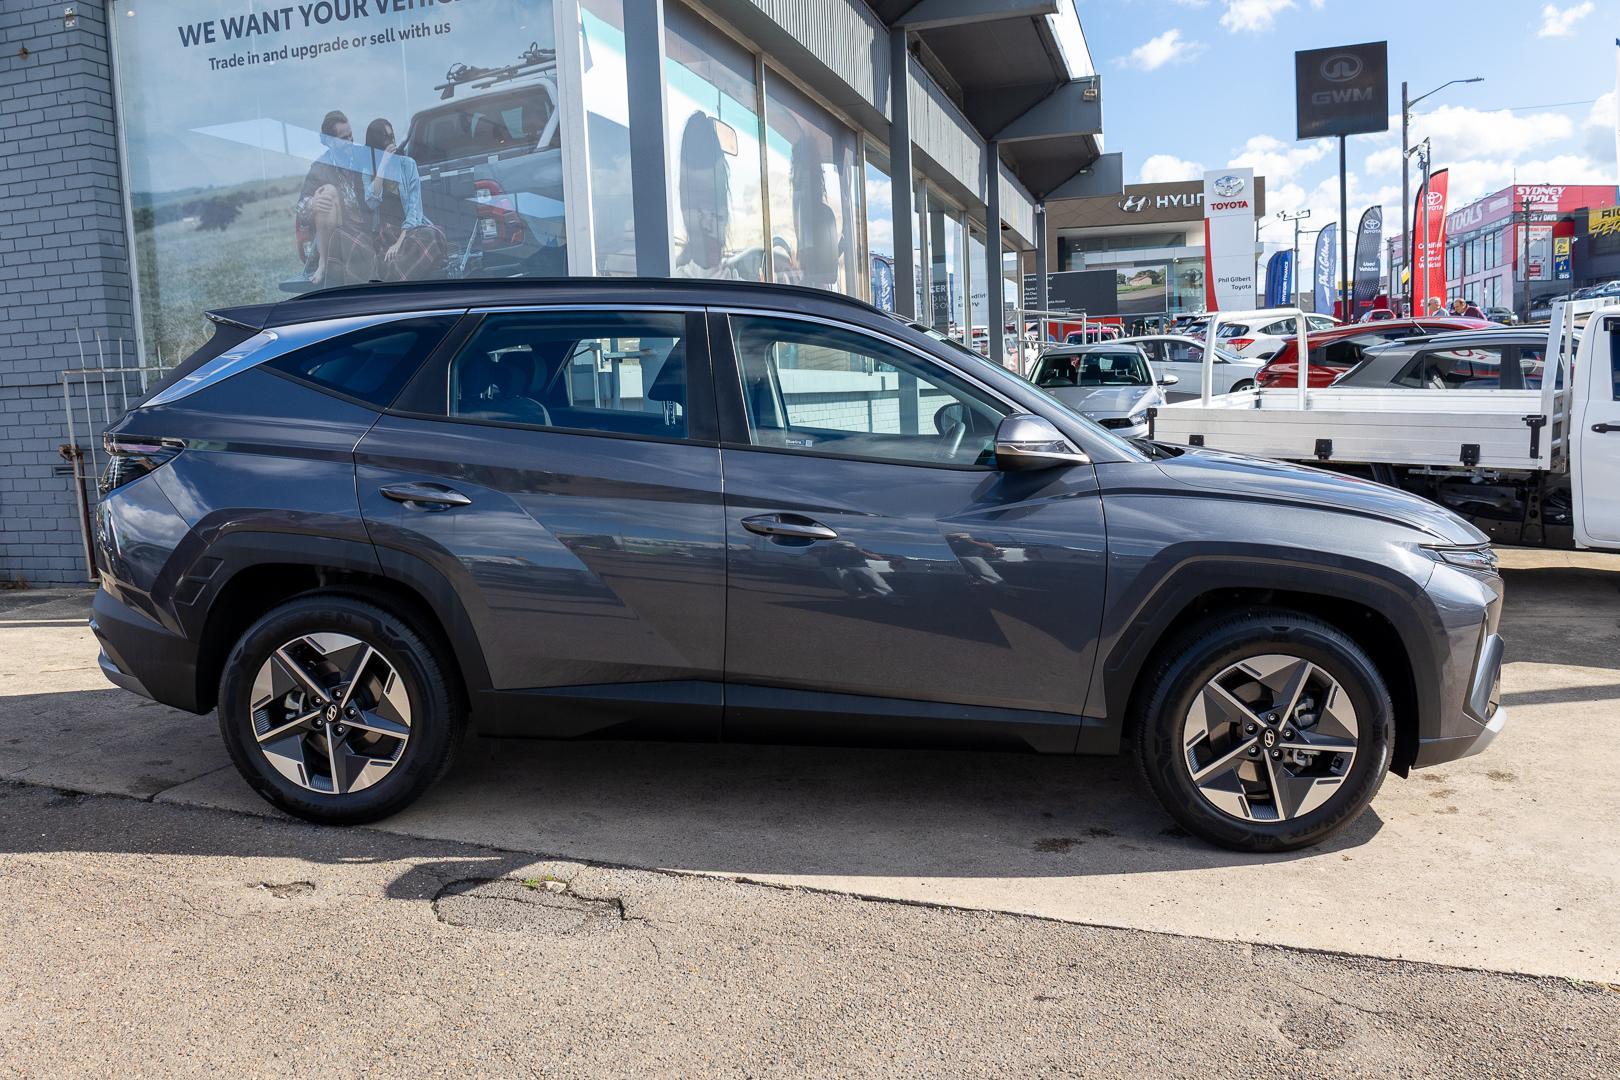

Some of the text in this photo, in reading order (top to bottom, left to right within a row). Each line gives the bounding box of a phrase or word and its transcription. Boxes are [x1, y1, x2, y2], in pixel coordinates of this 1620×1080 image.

[178, 21, 216, 48] WE
[219, 7, 294, 41] WANT
[298, 0, 369, 27] YOUR
[208, 22, 451, 71] Trade in and upgrade or sell with us
[1312, 87, 1373, 105] GWM
[1516, 186, 1566, 196] SYDNEY
[1521, 194, 1559, 203] TOOLS
[1156, 193, 1204, 209] HYUN
[1211, 200, 1248, 211] TOYOTA
[1451, 203, 1483, 233] TOOLS
[1230, 275, 1251, 283] Gilbert
